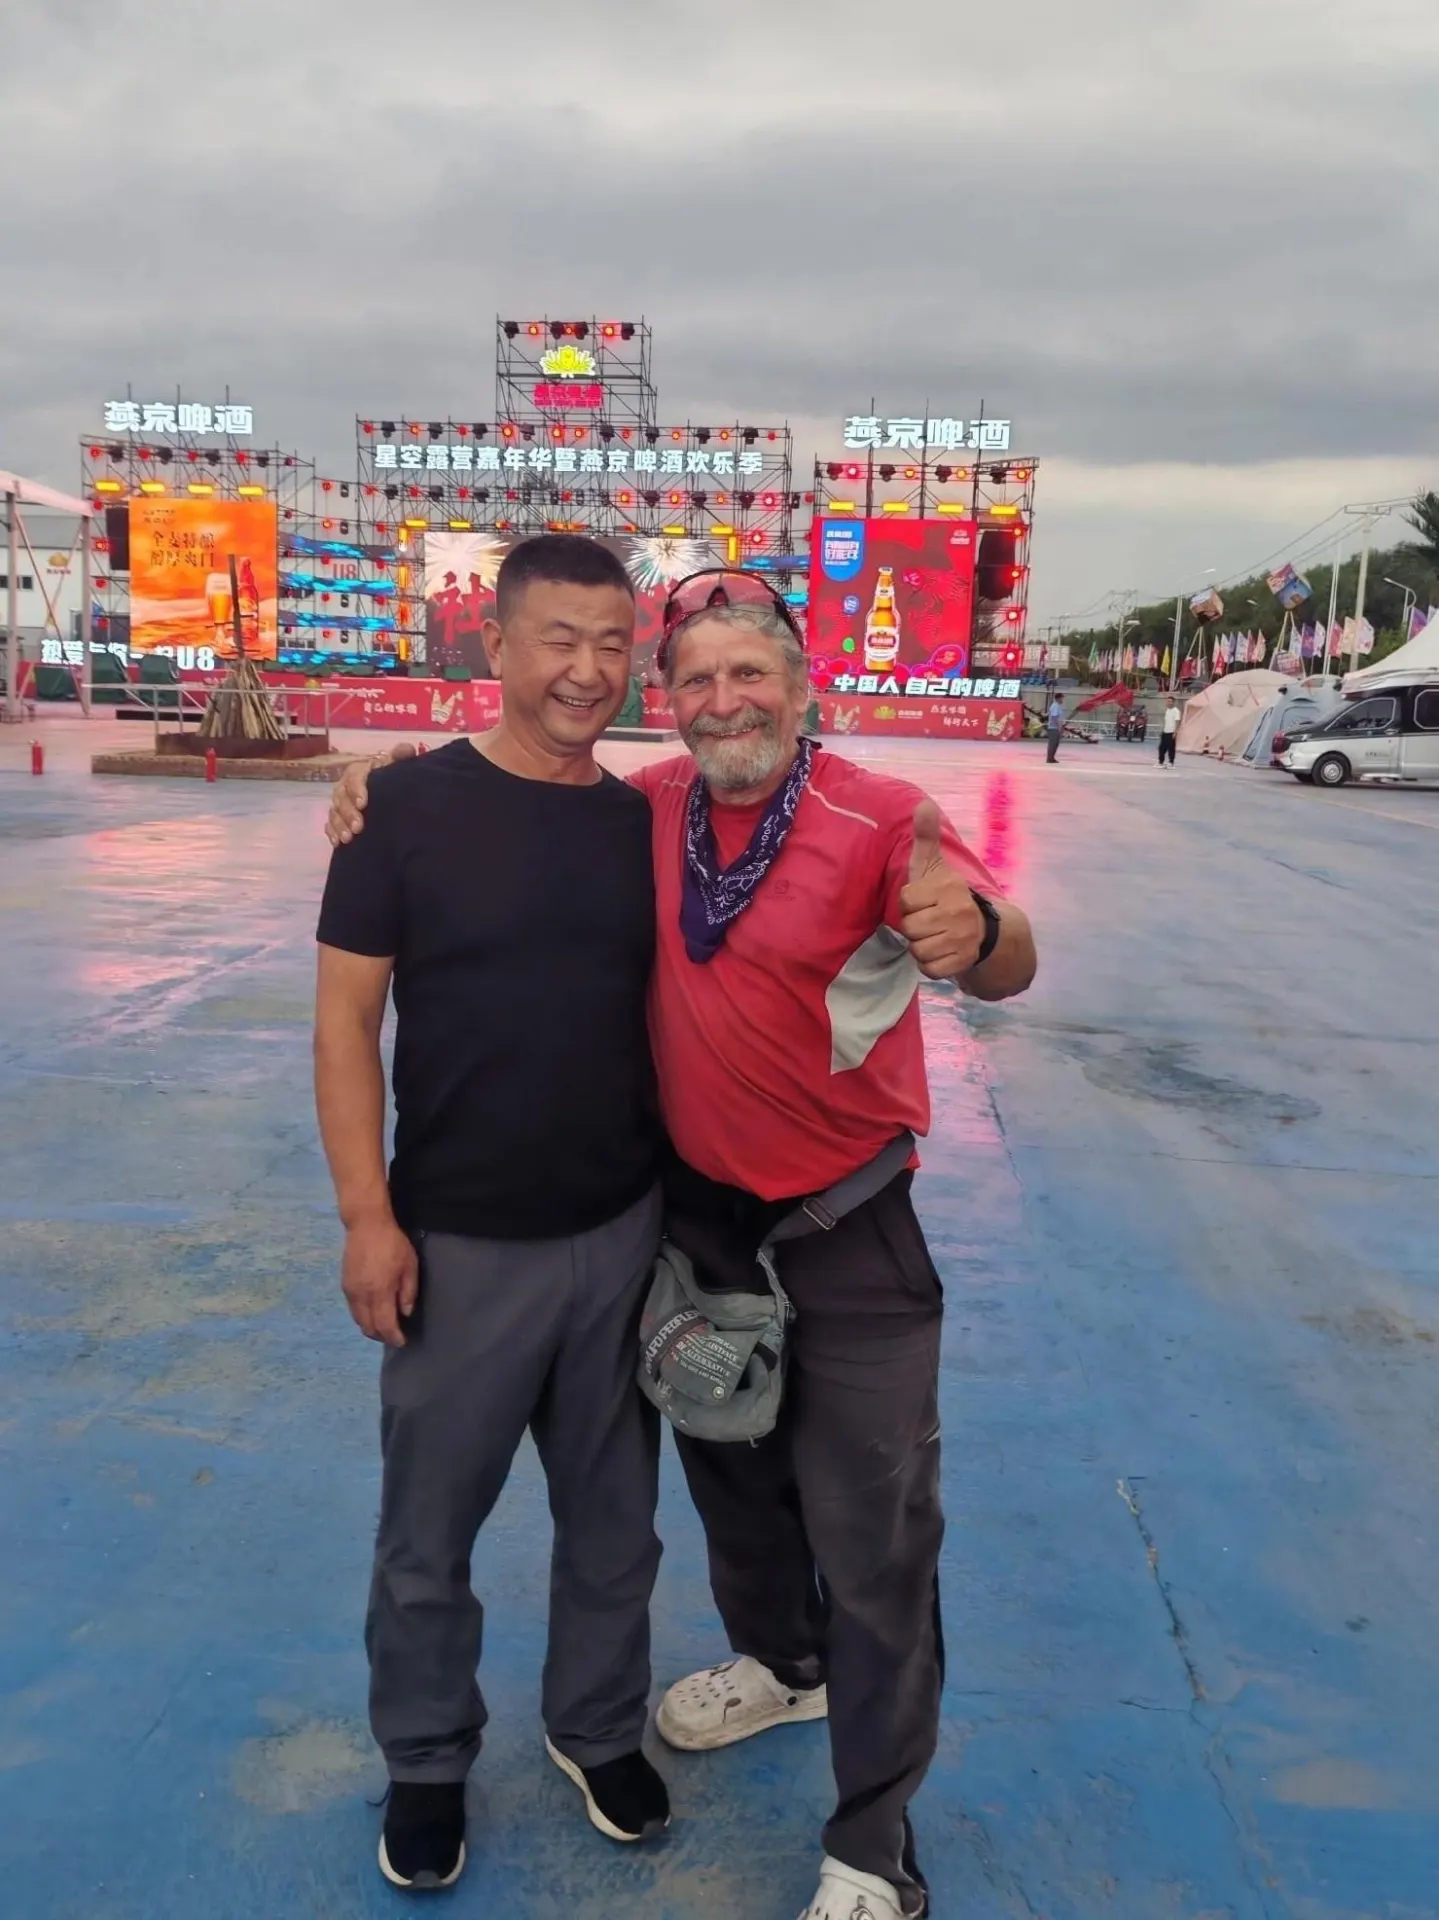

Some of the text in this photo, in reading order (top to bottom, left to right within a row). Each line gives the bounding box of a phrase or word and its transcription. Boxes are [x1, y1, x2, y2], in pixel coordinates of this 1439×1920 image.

[104, 400, 253, 435] 燕京啤酒
[844, 415, 1011, 450] 燕京啤酒
[375, 444, 763, 475] 星空露营嘉年华暨燕京啤酒欢乐季
[834, 674, 1021, 698] 中国人自己的啤酒
